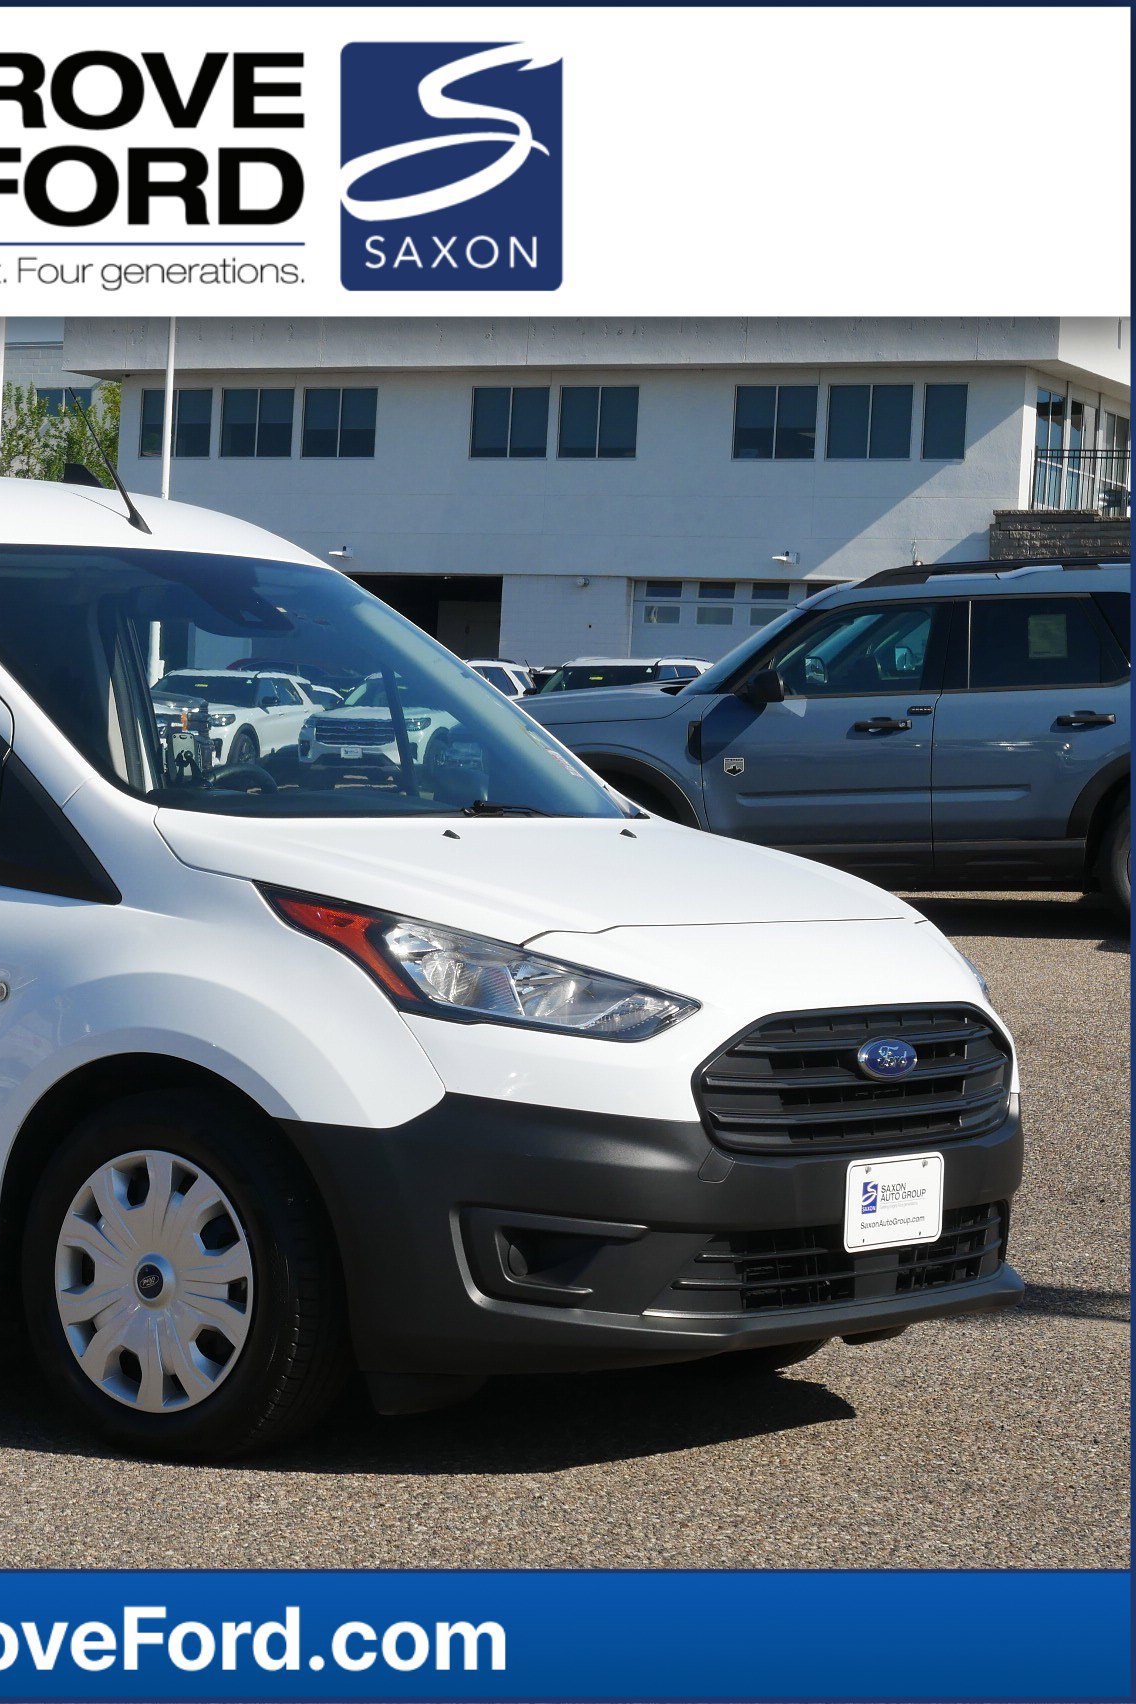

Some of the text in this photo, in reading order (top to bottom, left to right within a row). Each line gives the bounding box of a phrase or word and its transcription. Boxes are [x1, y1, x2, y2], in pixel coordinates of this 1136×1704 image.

[880, 1188, 927, 1202] AUTO GROUP
[881, 1183, 907, 1194] SAXON
[860, 1216, 926, 1230] SaxonAutoGroup.com
